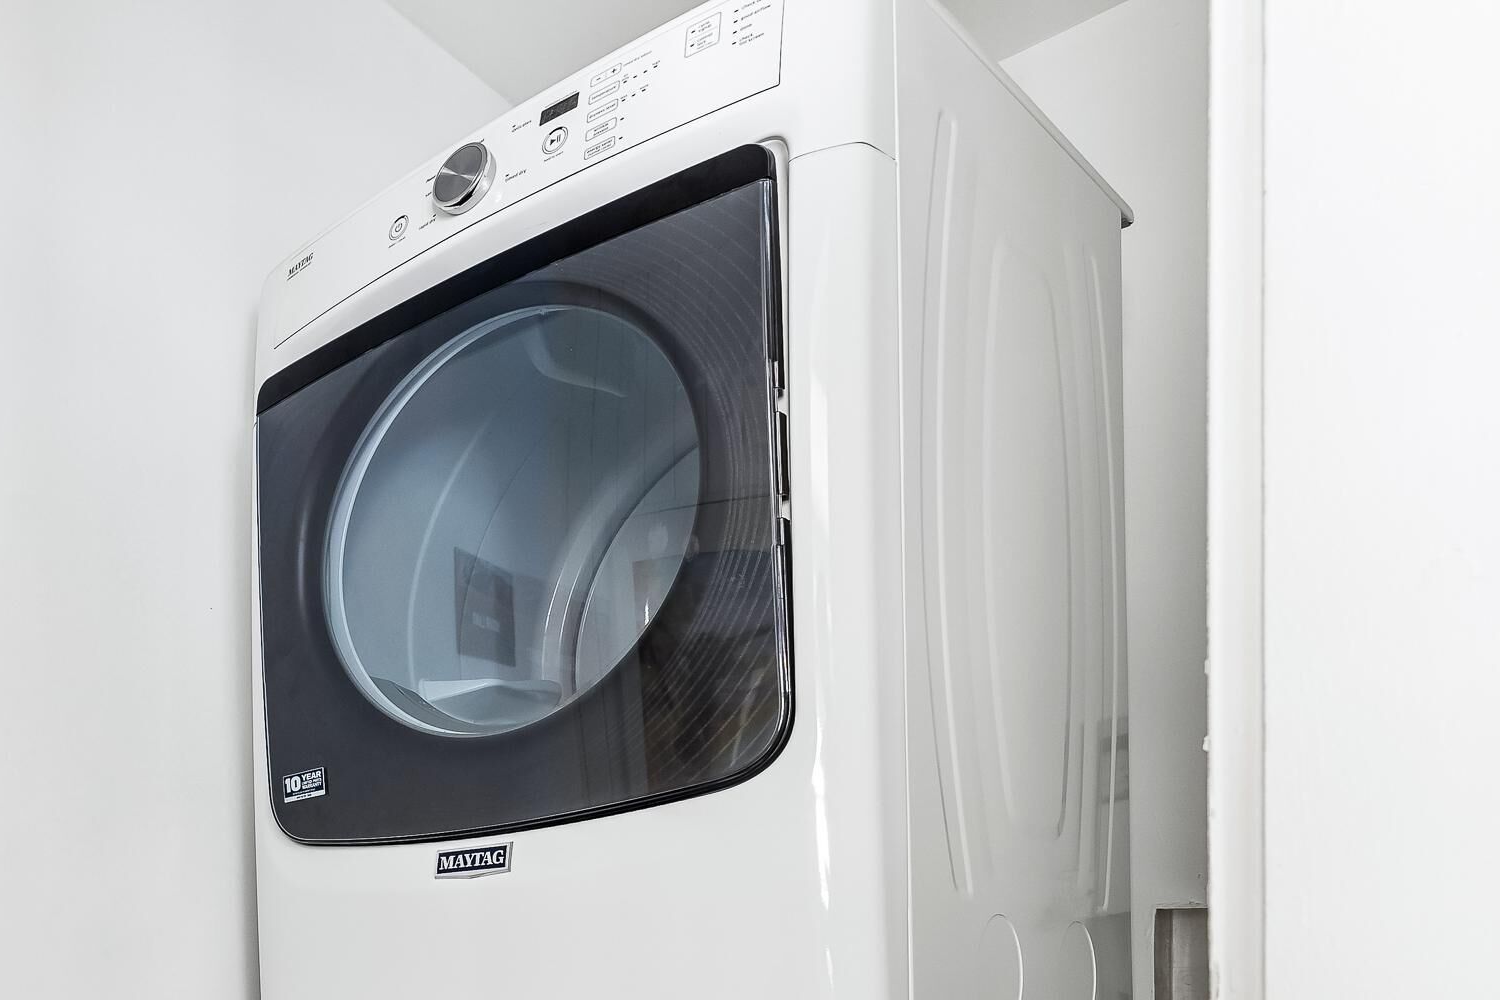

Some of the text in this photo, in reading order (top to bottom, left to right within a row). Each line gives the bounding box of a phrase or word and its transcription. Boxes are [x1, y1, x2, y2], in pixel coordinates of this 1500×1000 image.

[285, 776, 301, 793] 10
[301, 770, 321, 781] YEAR
[439, 849, 504, 870] MAYTAG
